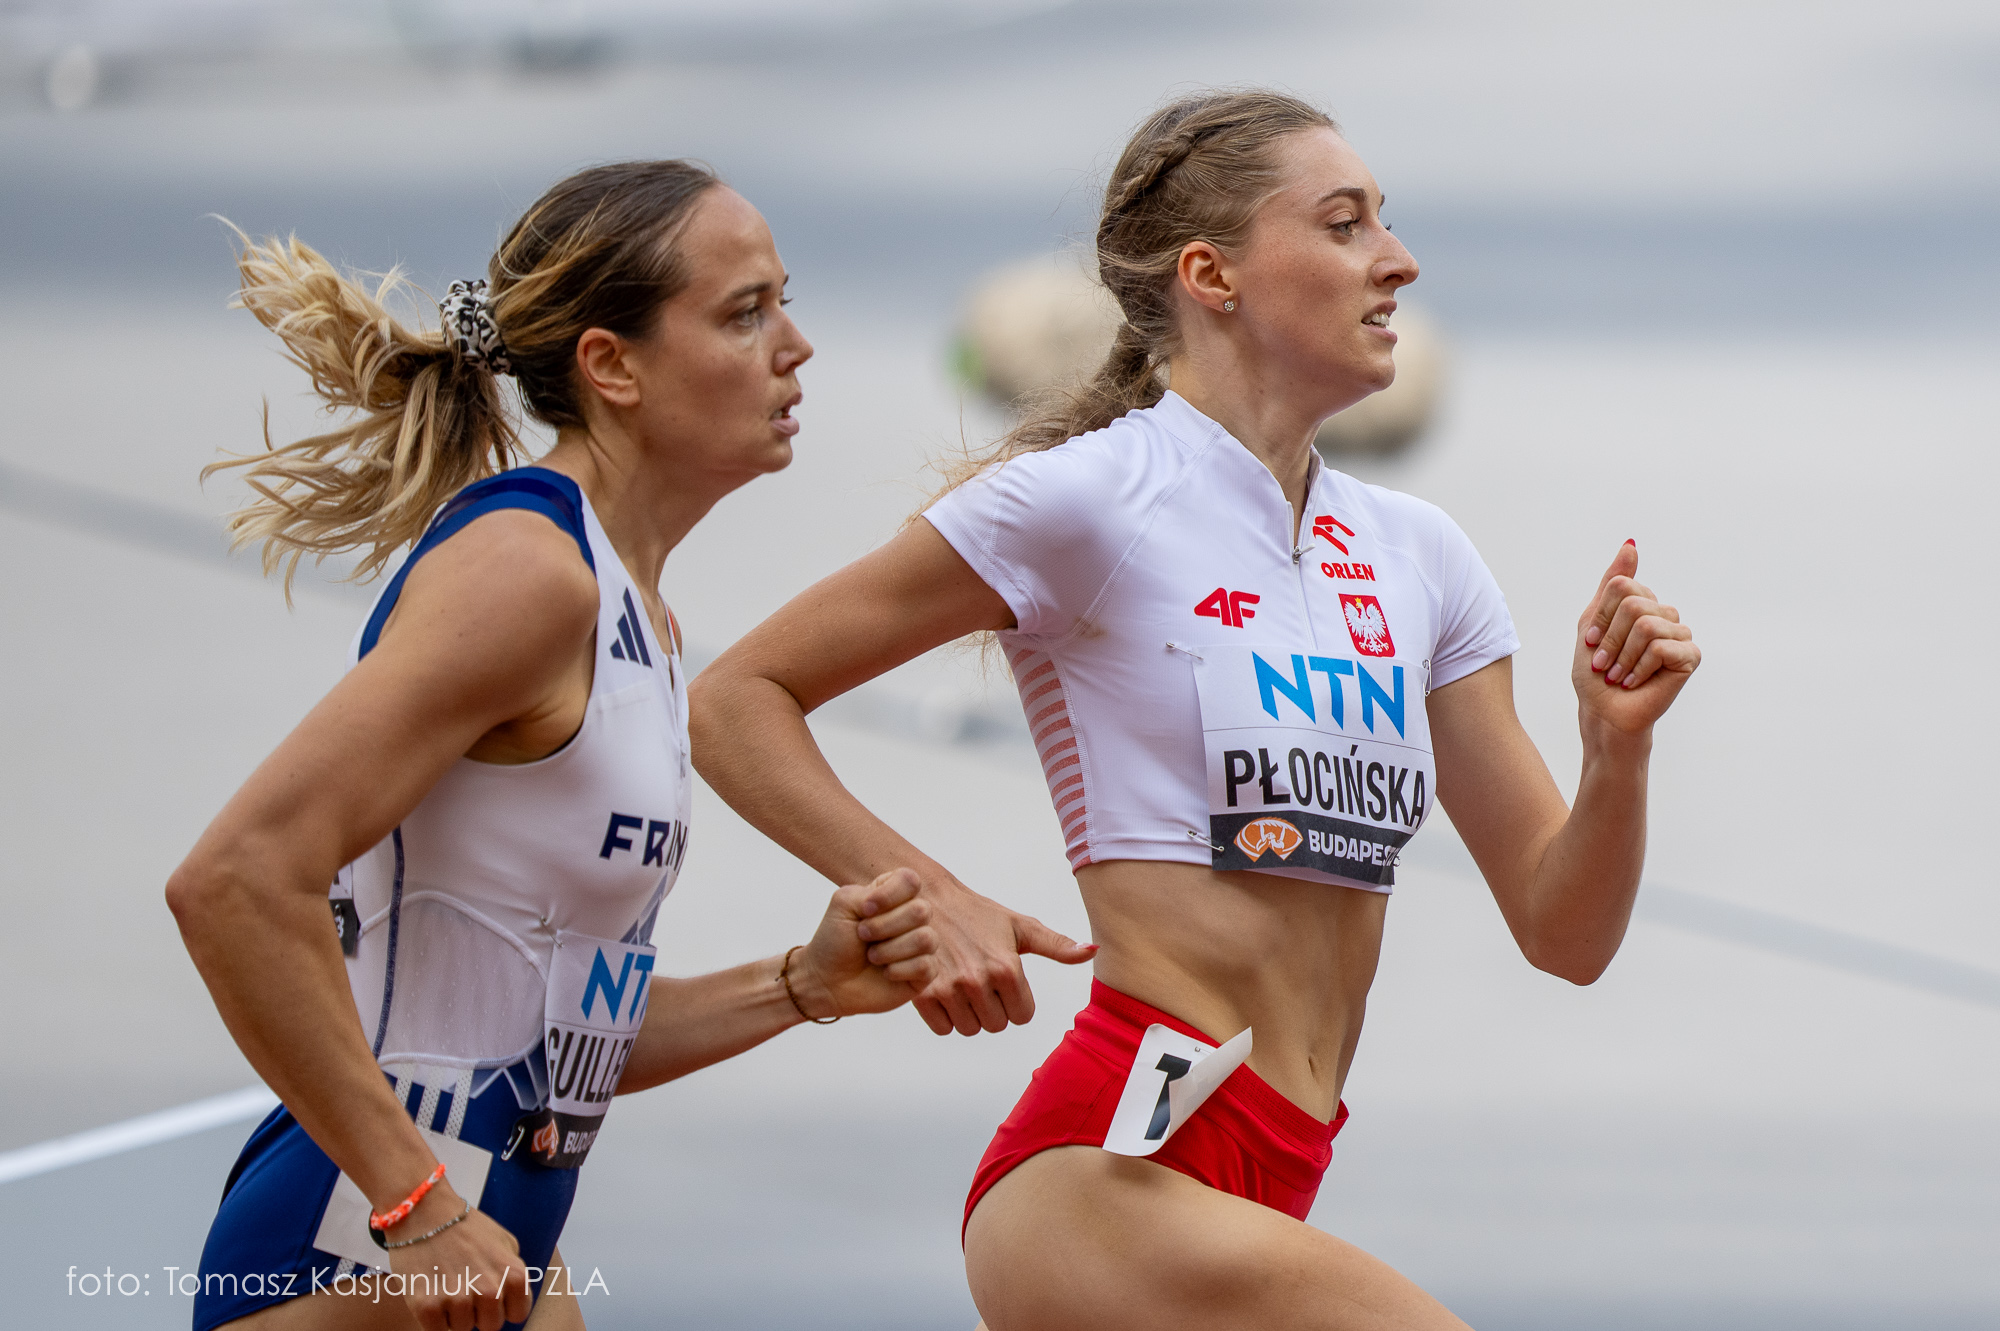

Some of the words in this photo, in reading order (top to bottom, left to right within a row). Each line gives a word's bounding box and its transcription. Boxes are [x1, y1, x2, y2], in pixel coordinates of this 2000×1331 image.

[1194, 587, 1261, 629] 4F
[1321, 562, 1376, 582] ORLEN
[1252, 651, 1405, 741] NTN
[1223, 744, 1426, 830] PŁOCIŃSKA
[581, 946, 655, 1027] NT
[548, 1027, 634, 1103] GUILLE
